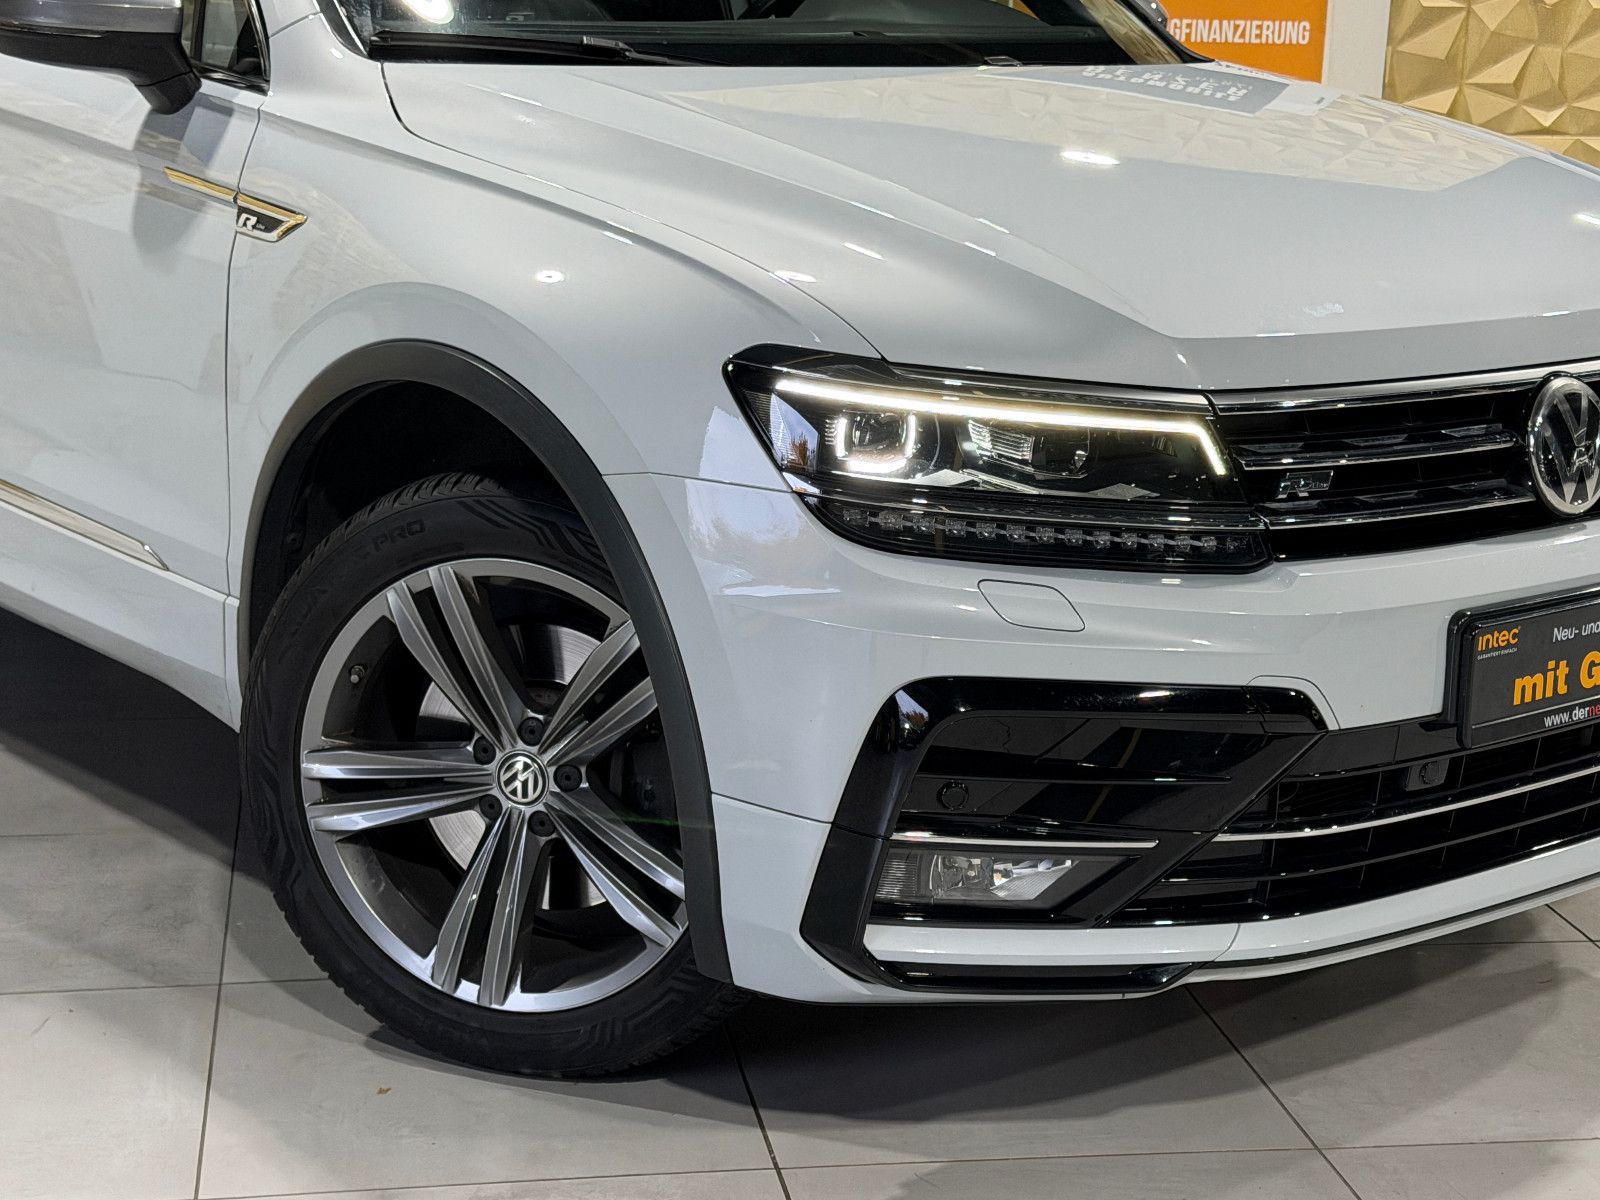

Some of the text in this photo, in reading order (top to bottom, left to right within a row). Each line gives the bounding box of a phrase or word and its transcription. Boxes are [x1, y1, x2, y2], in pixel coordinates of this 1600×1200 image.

[1167, 18, 1310, 45] GFINANZIERUNG
[237, 213, 257, 231] R
[373, 519, 426, 553] PRO
[1477, 627, 1520, 651] intec
[1552, 626, 1579, 643] Neu-
[1513, 660, 1569, 706] mit
